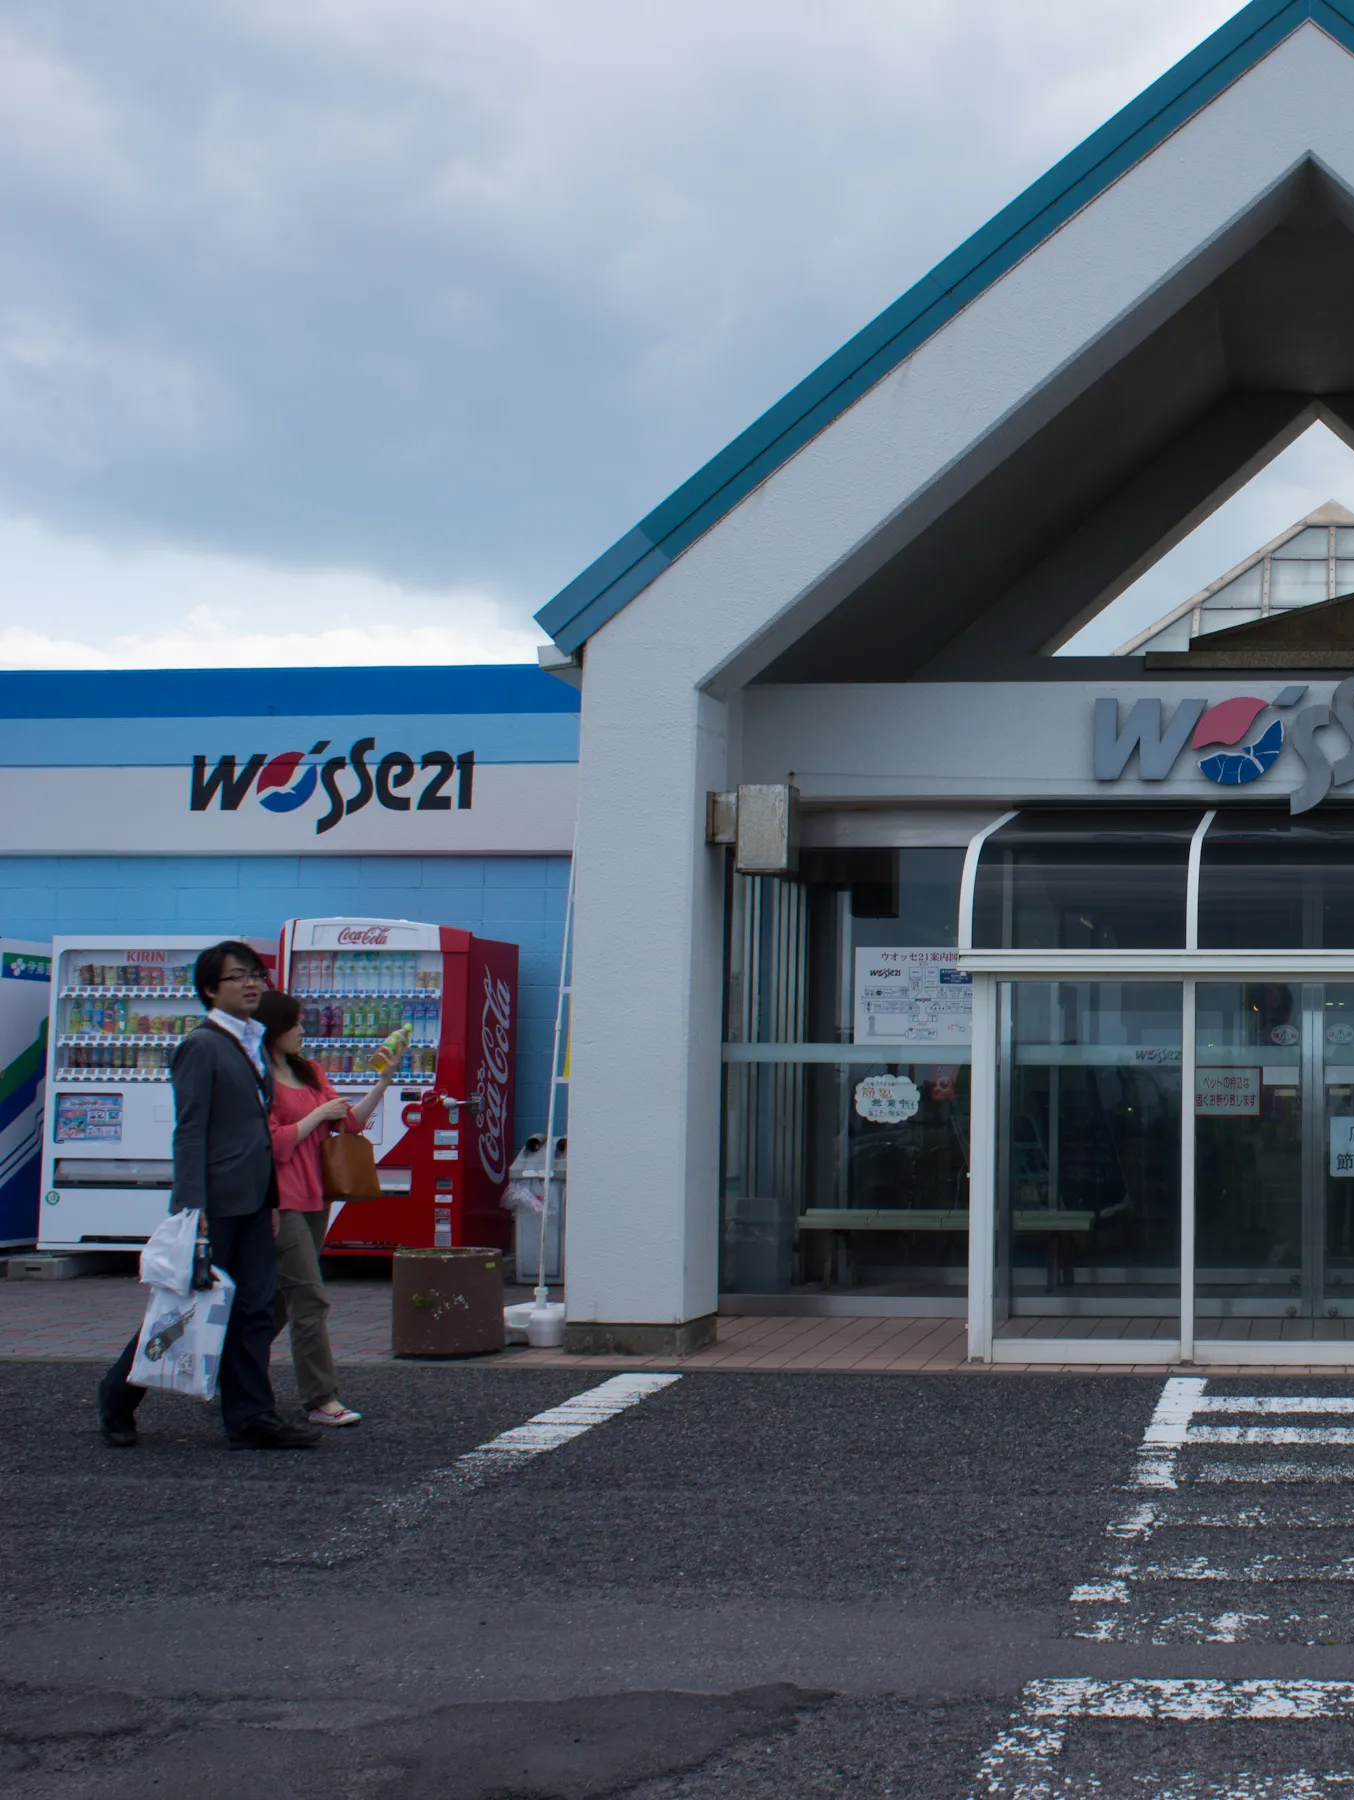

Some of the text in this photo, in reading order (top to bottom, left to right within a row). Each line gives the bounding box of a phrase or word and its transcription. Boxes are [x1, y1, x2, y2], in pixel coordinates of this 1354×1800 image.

[337, 926, 391, 946] Coca-Cola
[126, 951, 166, 963] KIRIN
[881, 951, 958, 962] ウオッセ21案内図
[478, 963, 511, 1184] Coca-Cola
[1203, 1076, 1250, 1089] ペットの持込は
